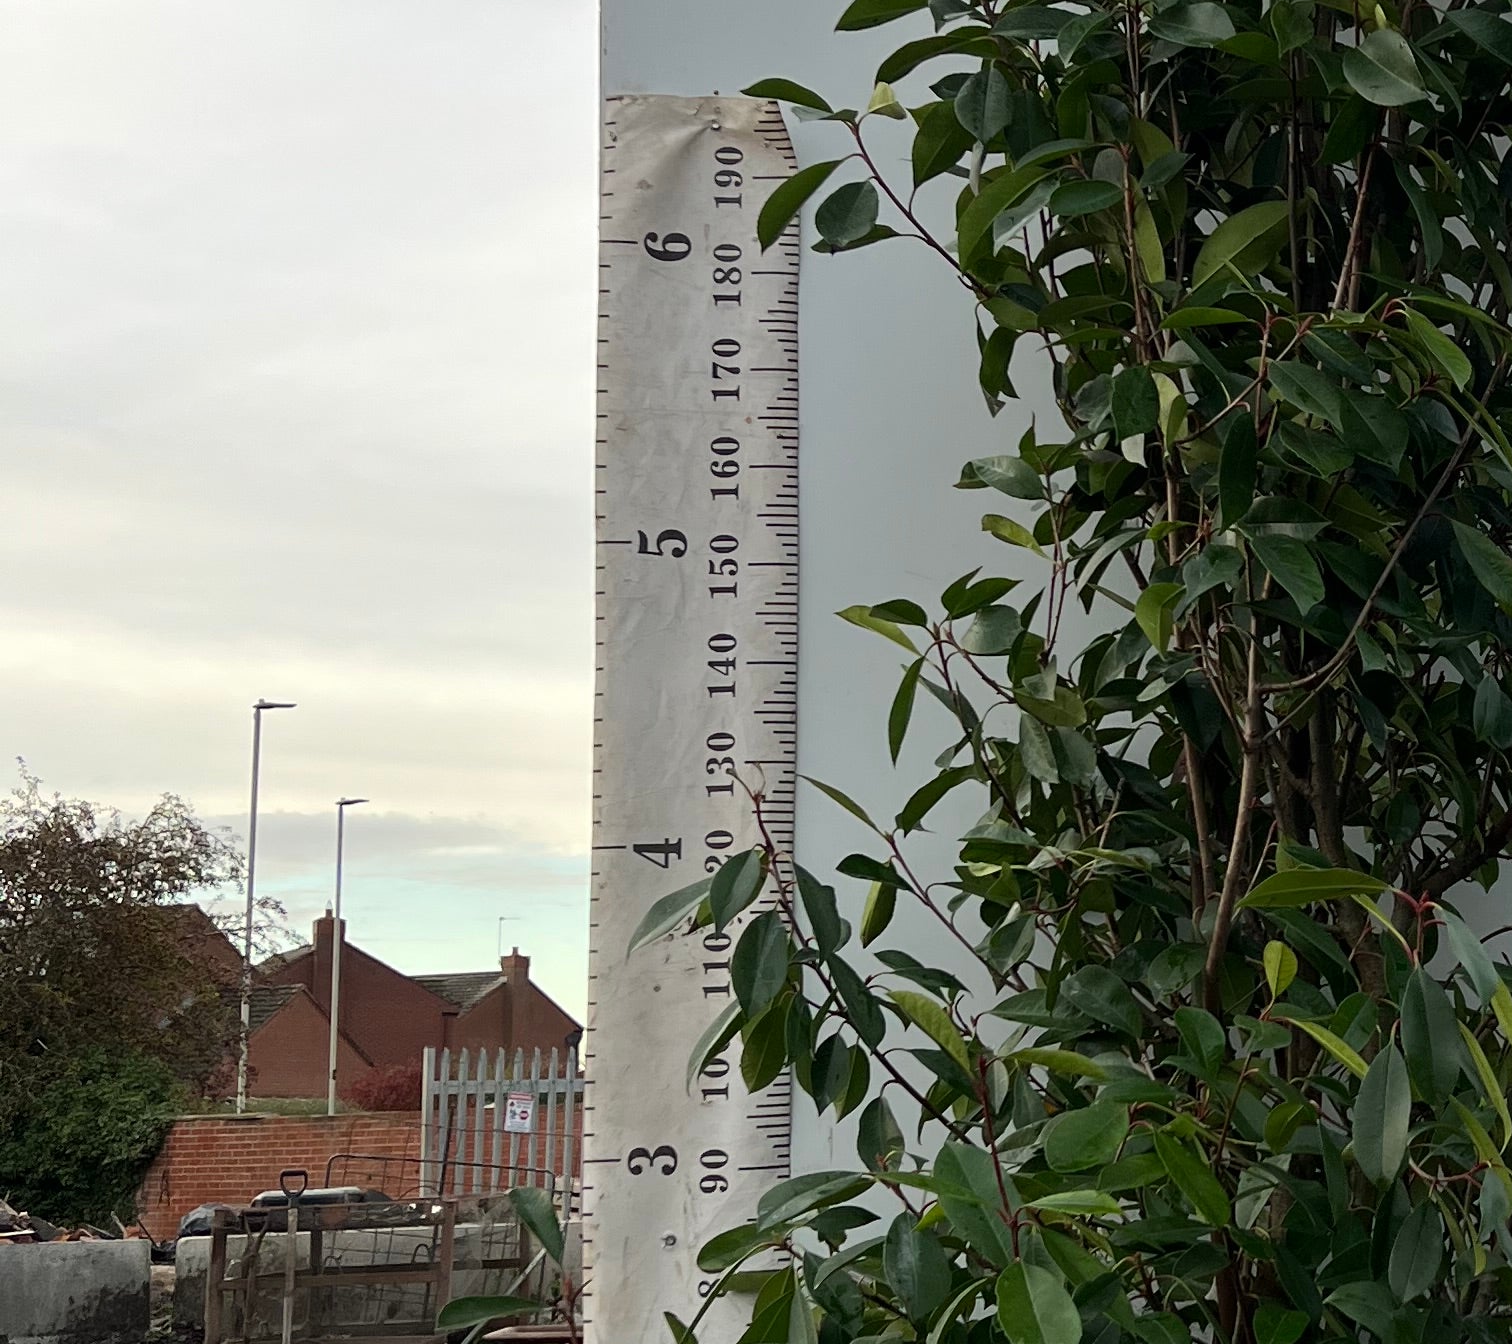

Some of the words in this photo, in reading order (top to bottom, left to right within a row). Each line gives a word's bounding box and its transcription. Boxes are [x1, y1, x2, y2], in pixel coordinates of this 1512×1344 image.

[714, 146, 743, 209] 190
[643, 231, 692, 262] 6
[713, 243, 742, 307] 180
[711, 338, 741, 402] 170
[710, 436, 740, 501] 160
[637, 529, 688, 558] 5
[708, 534, 739, 599] 150
[707, 633, 737, 698] 140
[705, 732, 736, 797] 130
[632, 837, 682, 869] 4
[702, 932, 731, 999] 110
[627, 1145, 678, 1176] 3
[699, 1149, 729, 1194] 90
